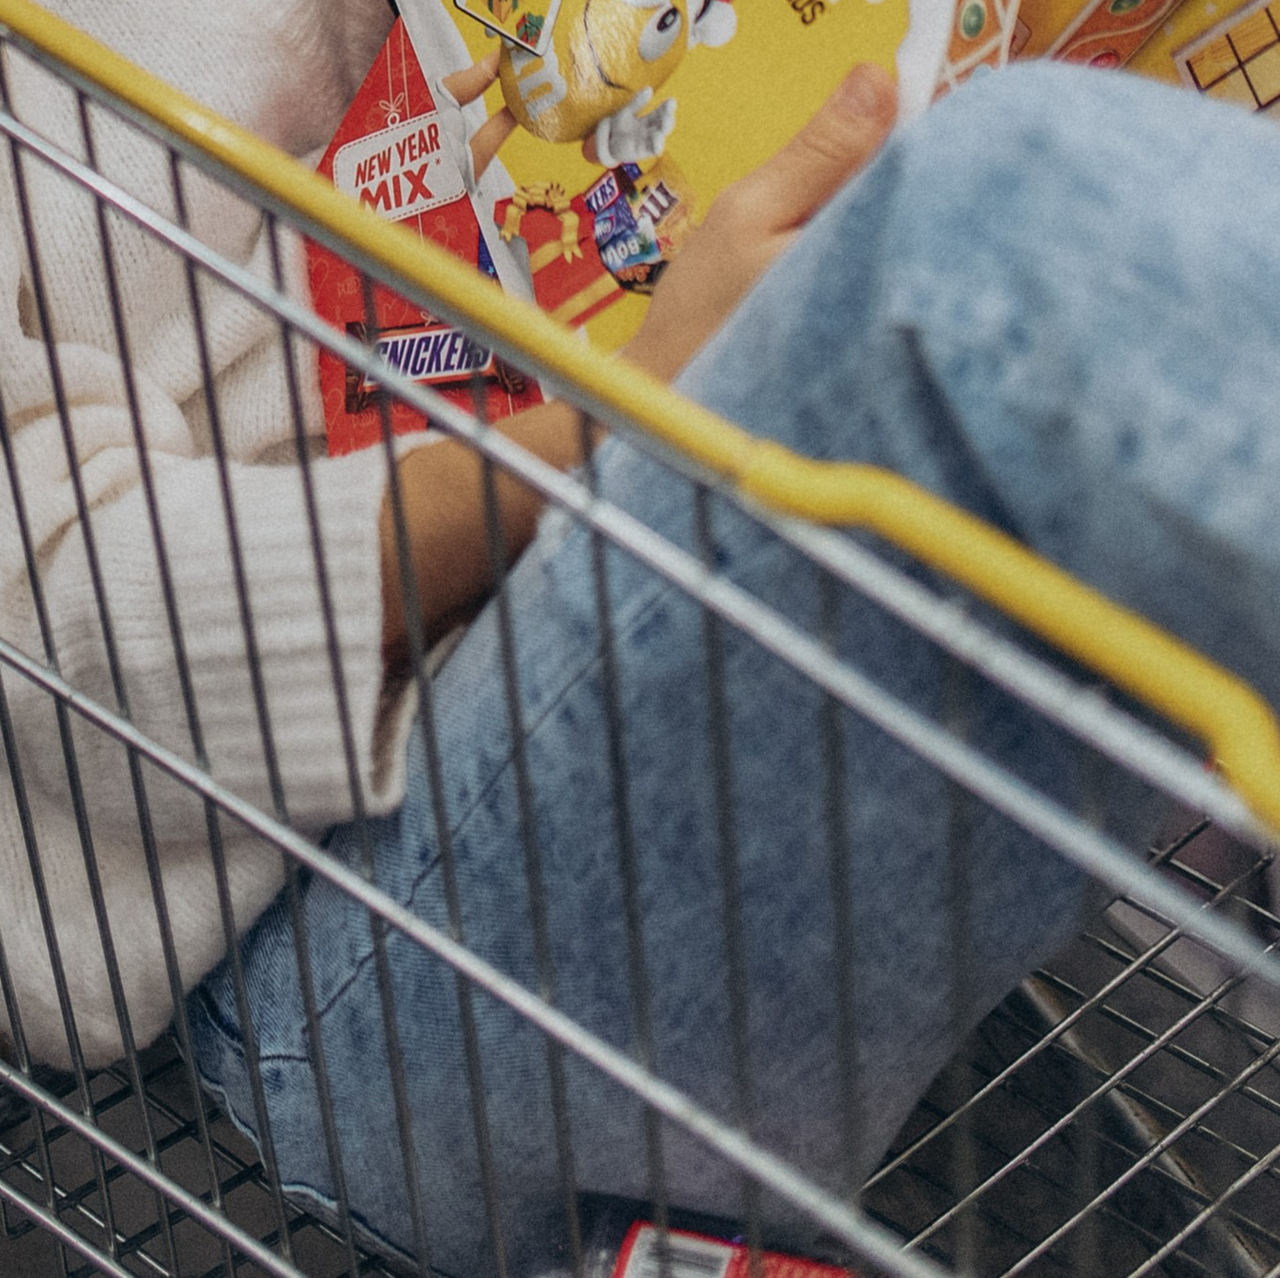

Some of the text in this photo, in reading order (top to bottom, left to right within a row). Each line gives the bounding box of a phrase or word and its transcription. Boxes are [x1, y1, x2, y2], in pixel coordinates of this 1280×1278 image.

[354, 123, 441, 188] NEW YEAR
[359, 161, 434, 212] MIX
